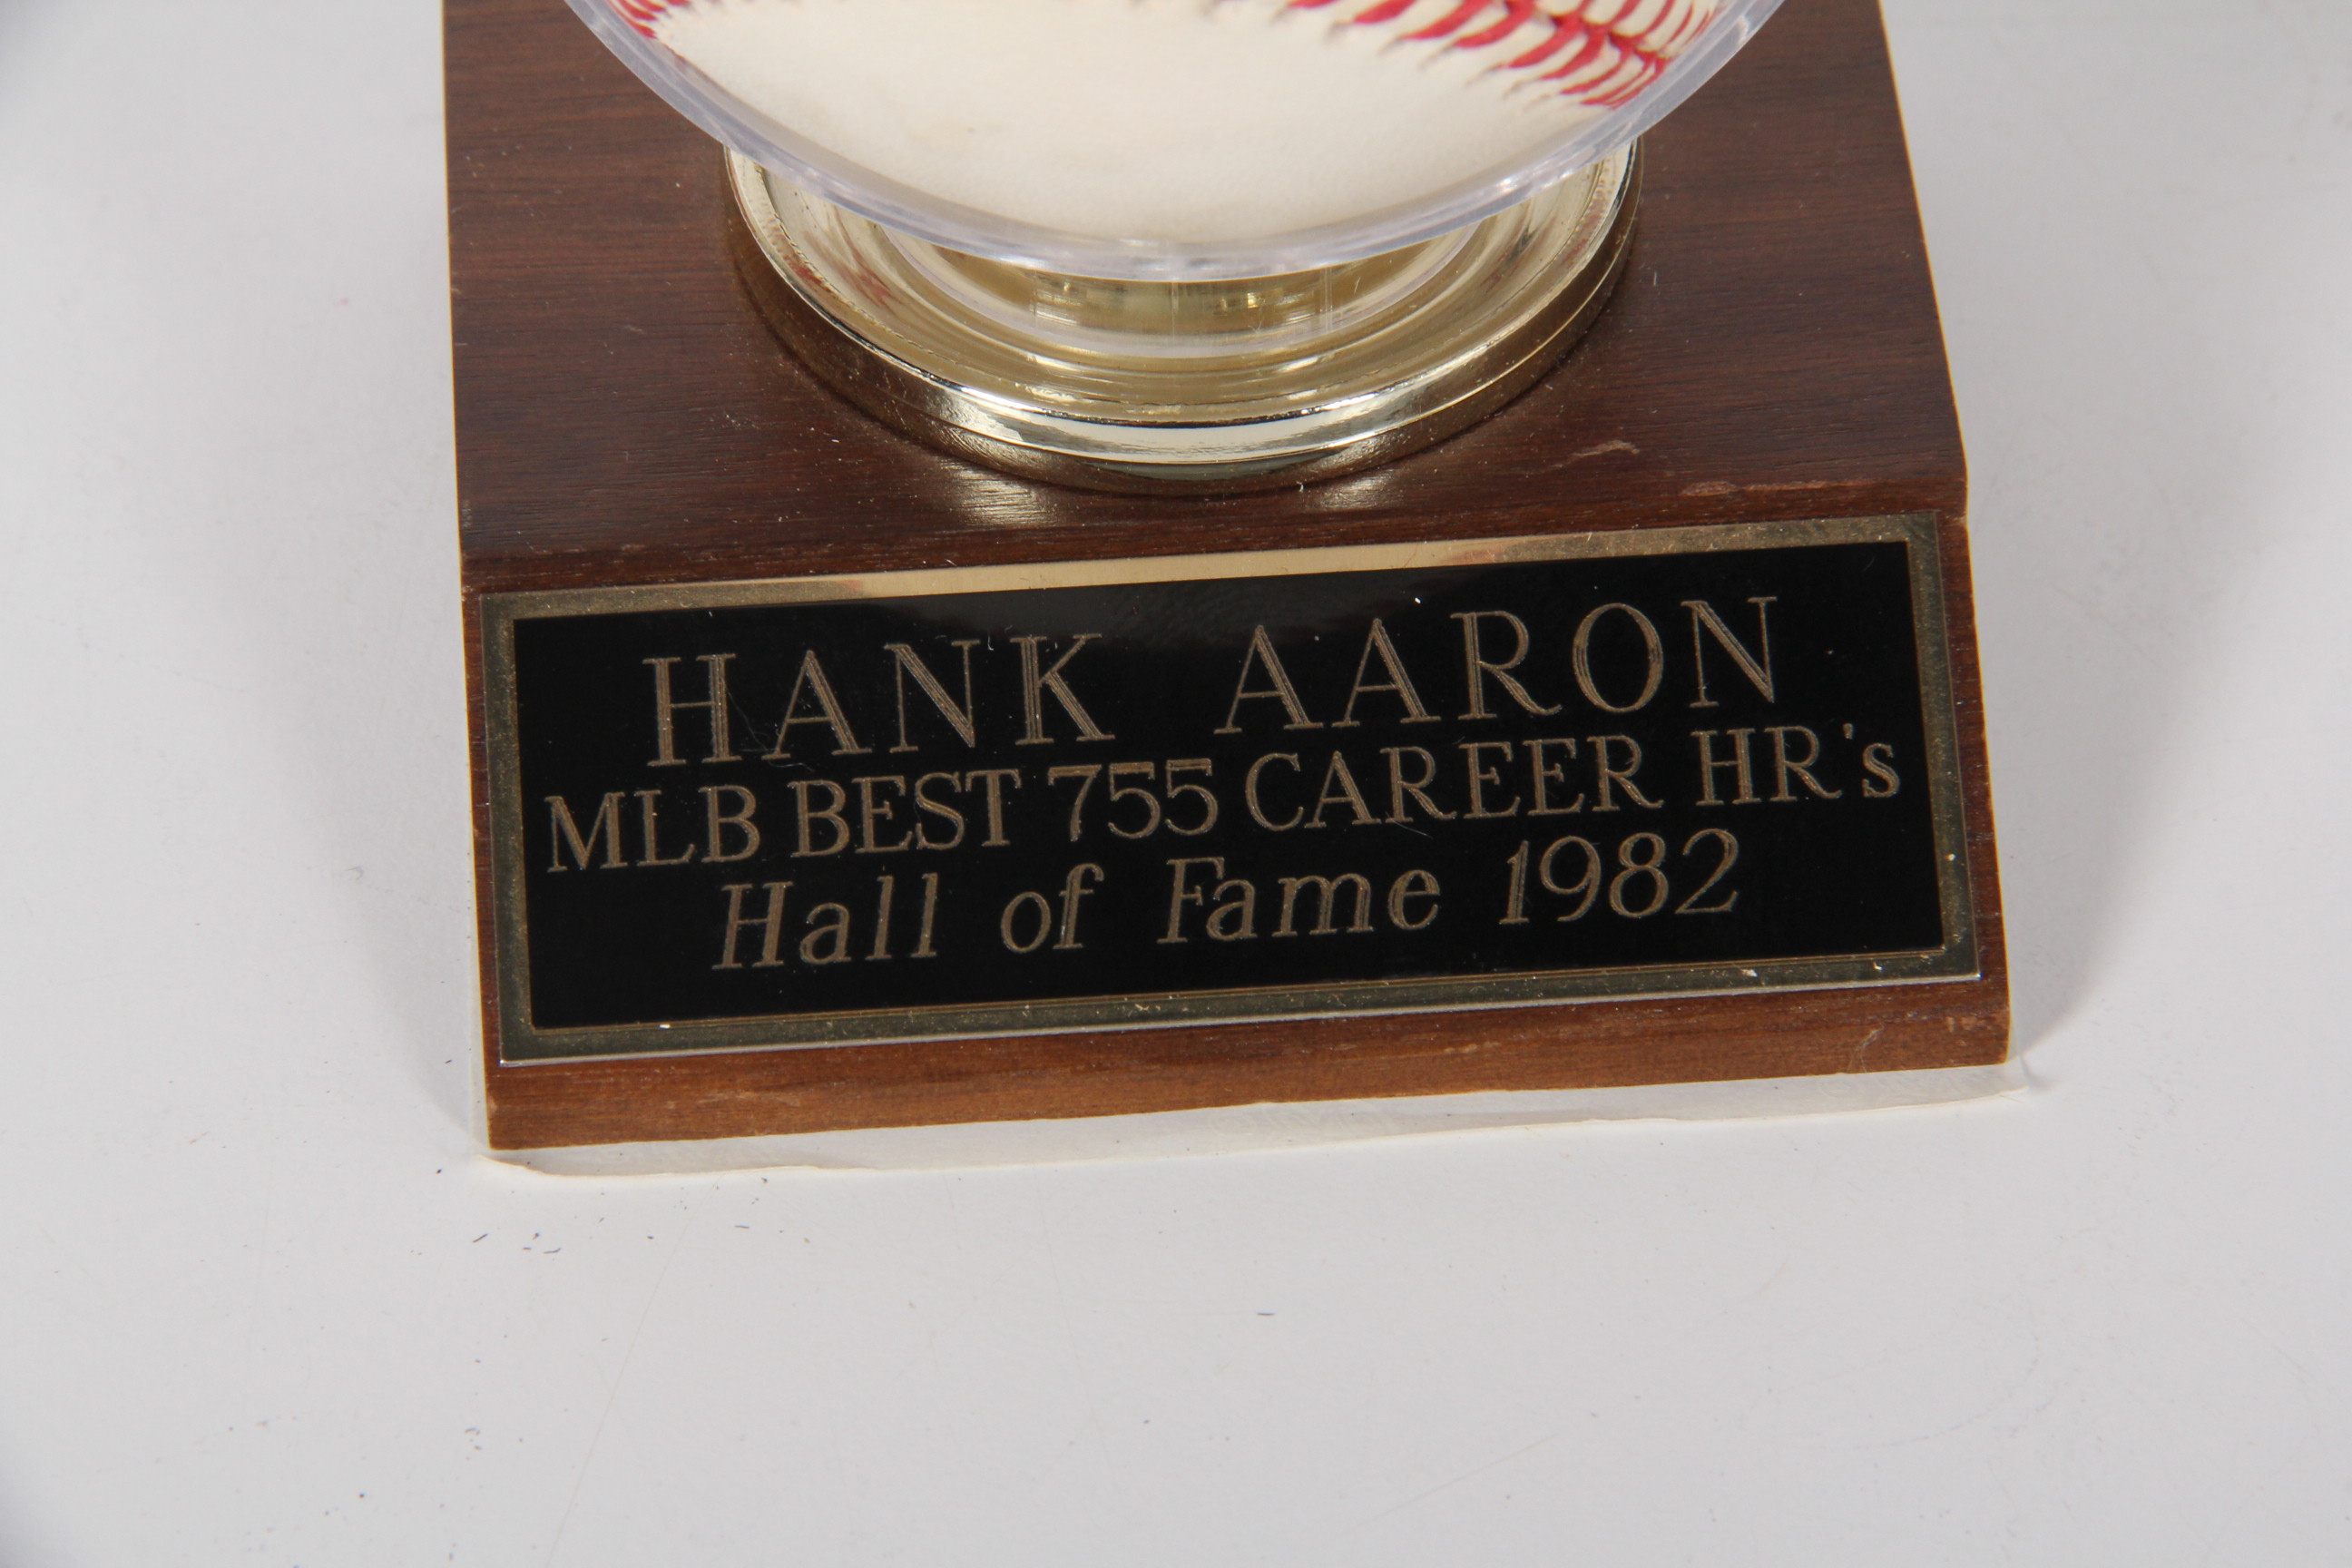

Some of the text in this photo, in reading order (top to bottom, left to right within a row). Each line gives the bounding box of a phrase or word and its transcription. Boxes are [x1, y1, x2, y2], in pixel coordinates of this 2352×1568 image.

[642, 596, 1778, 767] HANK AARON
[544, 722, 1902, 872] MLB BEST 755 CAREER HR's
[712, 828, 1740, 970] Hall of Fame 1982
